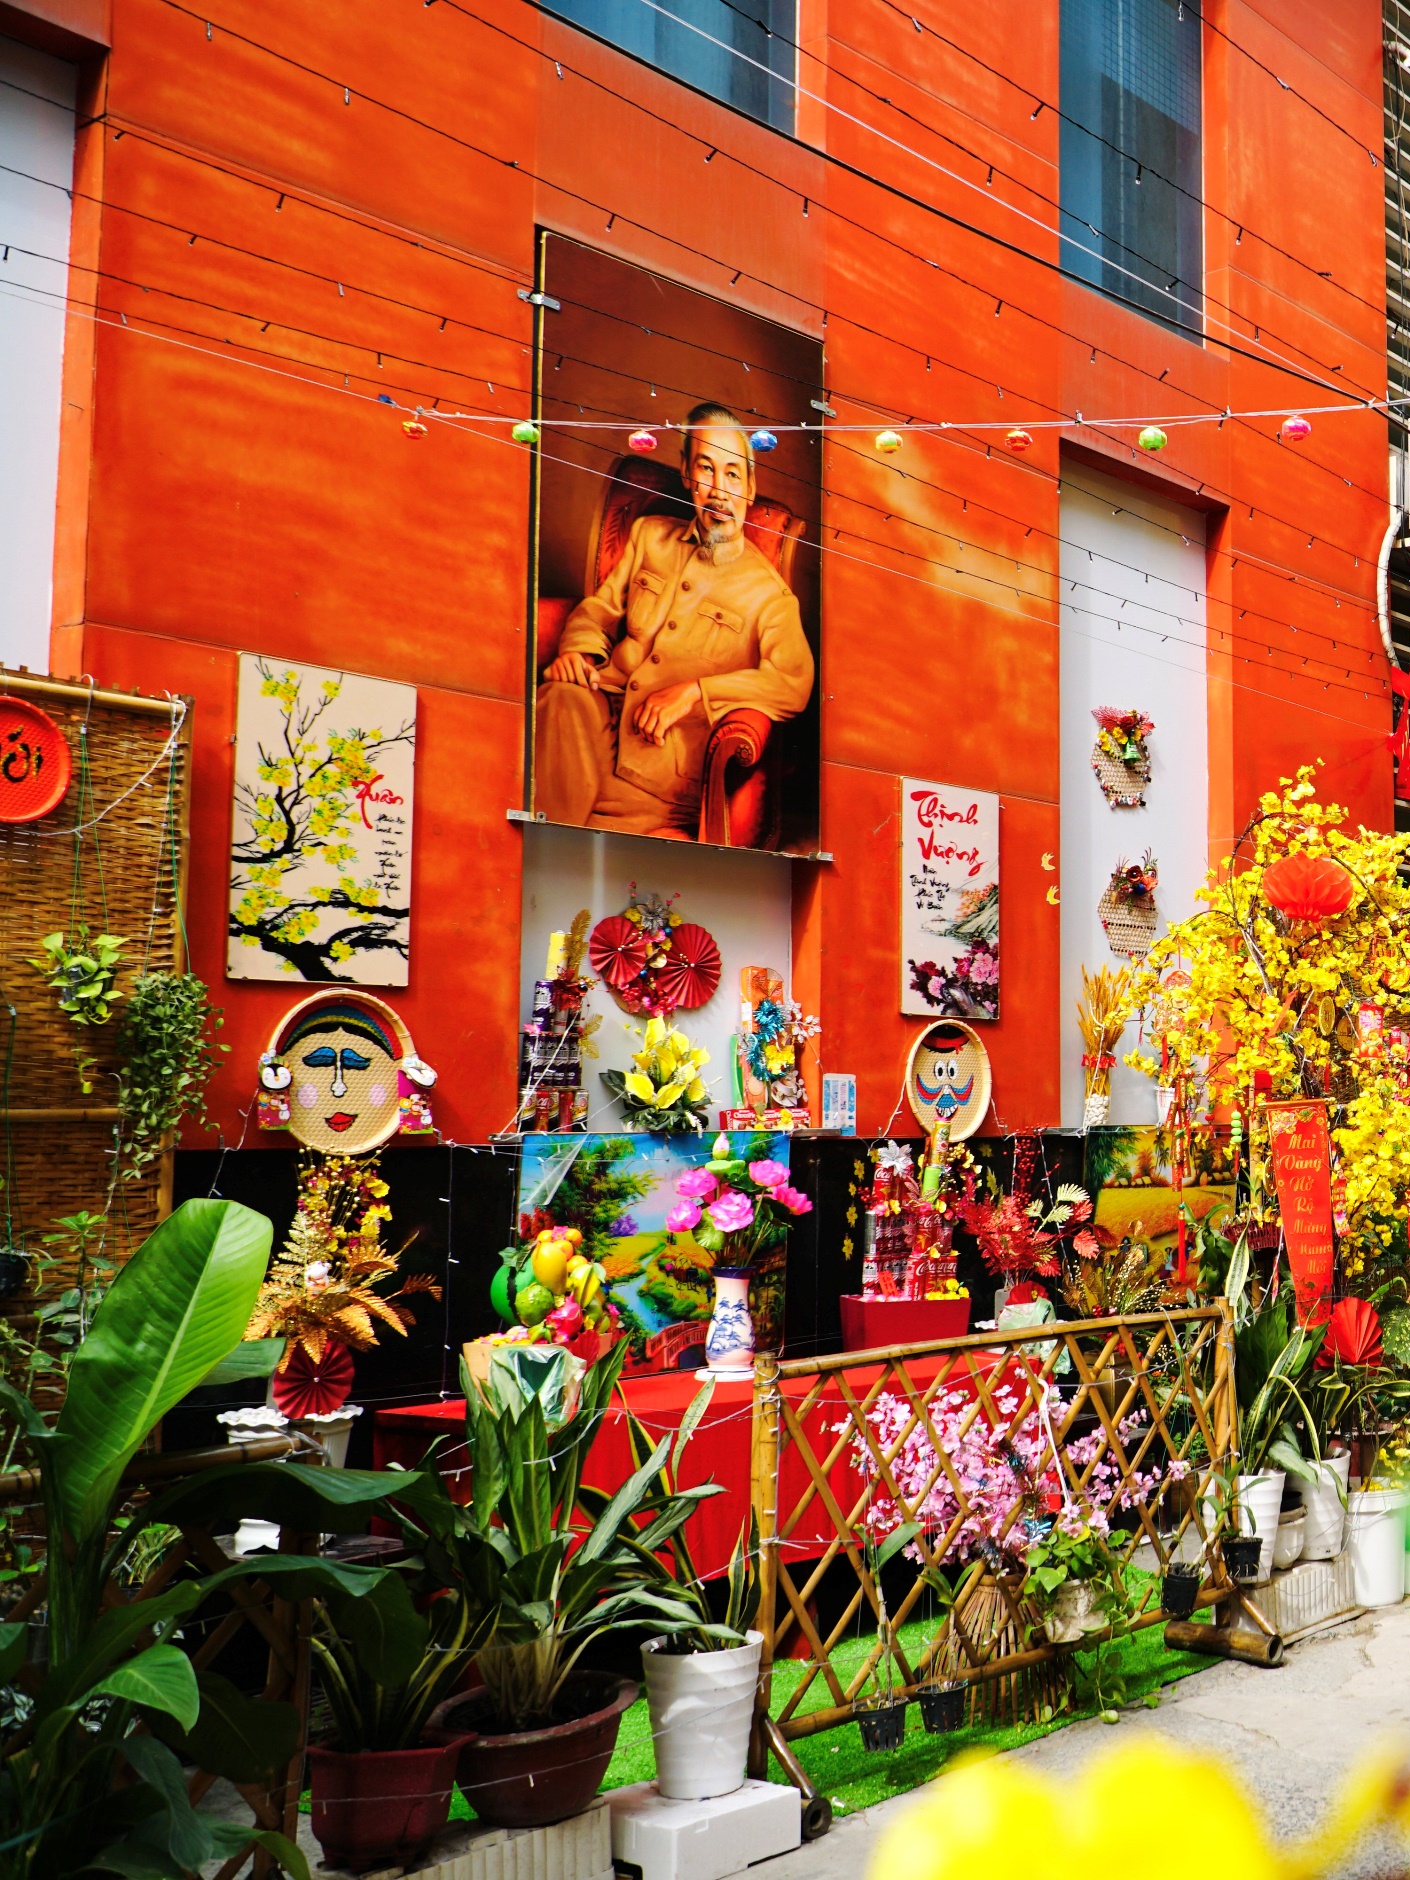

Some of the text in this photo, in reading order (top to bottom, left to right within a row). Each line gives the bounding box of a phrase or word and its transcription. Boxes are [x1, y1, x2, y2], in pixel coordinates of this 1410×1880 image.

[910, 790, 979, 828] Thịnh
[917, 829, 989, 877] Vượng
[1287, 1133, 1317, 1150] Mai
[1280, 1154, 1322, 1172] Vàng
[1293, 1196, 1315, 1215] Rộ
